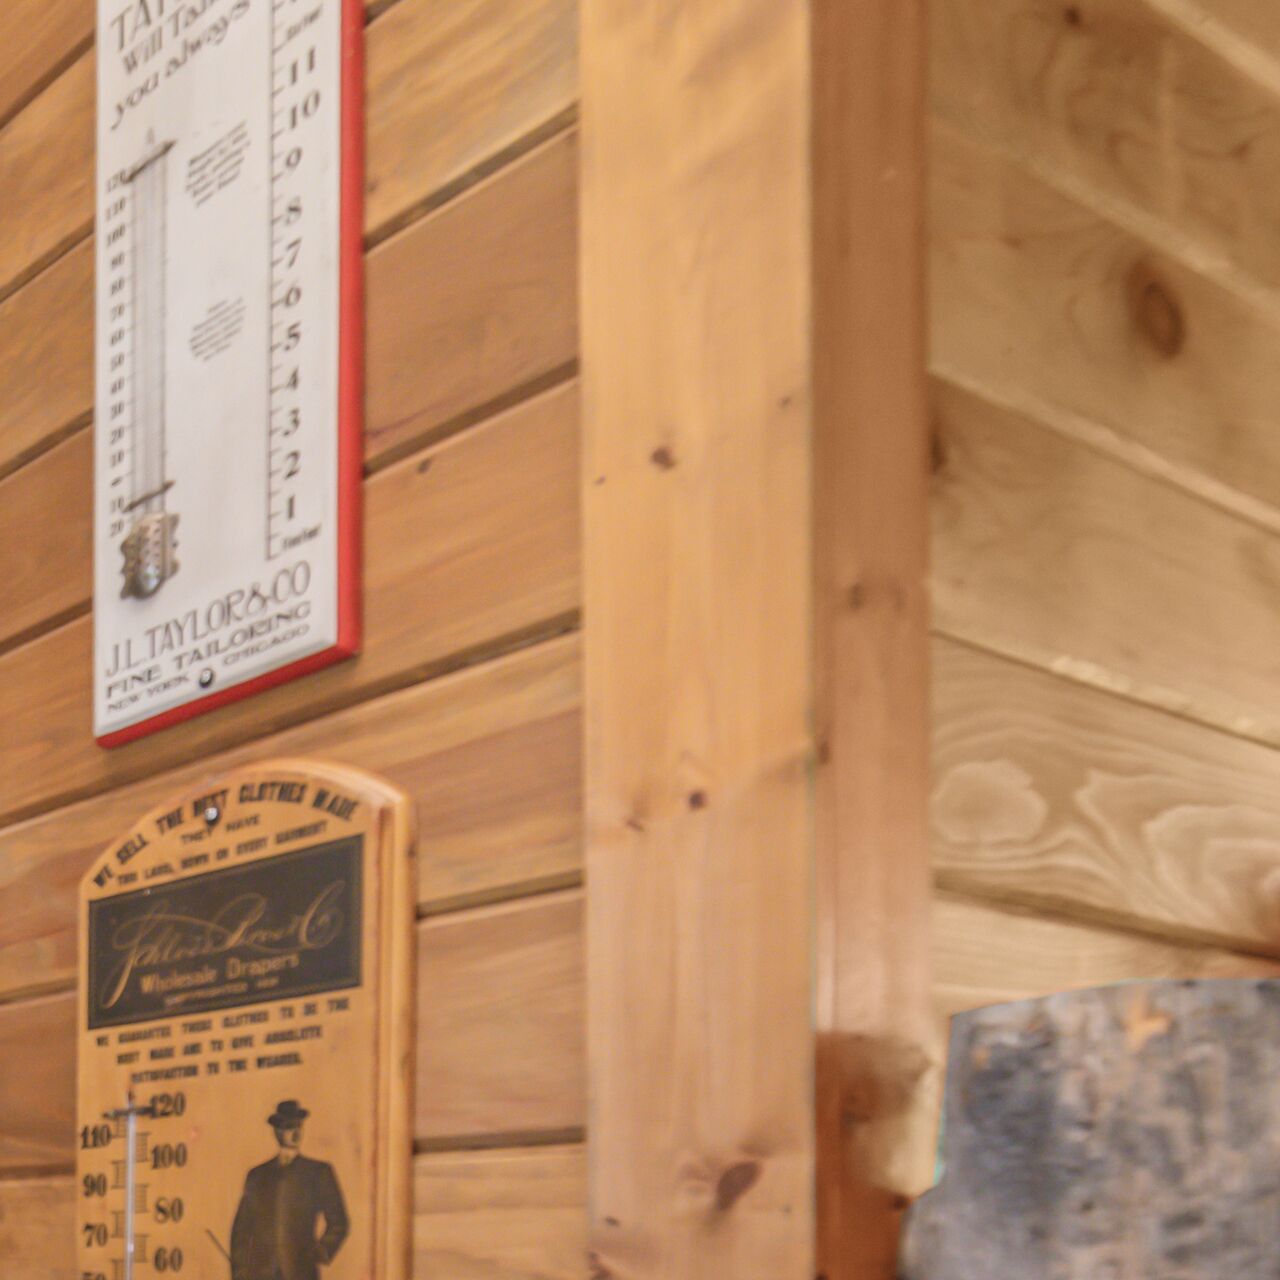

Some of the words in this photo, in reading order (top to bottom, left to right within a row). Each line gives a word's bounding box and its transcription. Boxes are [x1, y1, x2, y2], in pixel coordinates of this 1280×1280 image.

[290, 48, 317, 85] 11
[110, 72, 159, 131] you
[290, 89, 320, 130] 10
[287, 237, 302, 269] 7
[284, 321, 301, 352] 5
[285, 365, 300, 391] 4
[109, 427, 125, 445] 20
[283, 407, 300, 437] 3
[284, 450, 300, 480] 2
[287, 494, 295, 521] 1
[107, 664, 161, 699] FINE
[173, 601, 310, 670] TAILORING
[107, 694, 139, 712] NEW
[147, 672, 190, 697] YORK
[222, 624, 309, 665] CHICAGO
[93, 865, 114, 888] WE
[116, 834, 149, 865] SELL
[156, 807, 185, 835] THE
[239, 781, 308, 804] CLOTHES
[312, 788, 359, 822] MADE
[140, 964, 218, 993] Wholesale
[225, 953, 301, 981] Drapers
[149, 1091, 187, 1118] 120
[80, 1124, 111, 1149] 110
[151, 1142, 187, 1170] 100
[83, 1172, 108, 1198] 90
[154, 1197, 184, 1223] 80
[83, 1222, 108, 1248] 70
[154, 1246, 184, 1273] 60
